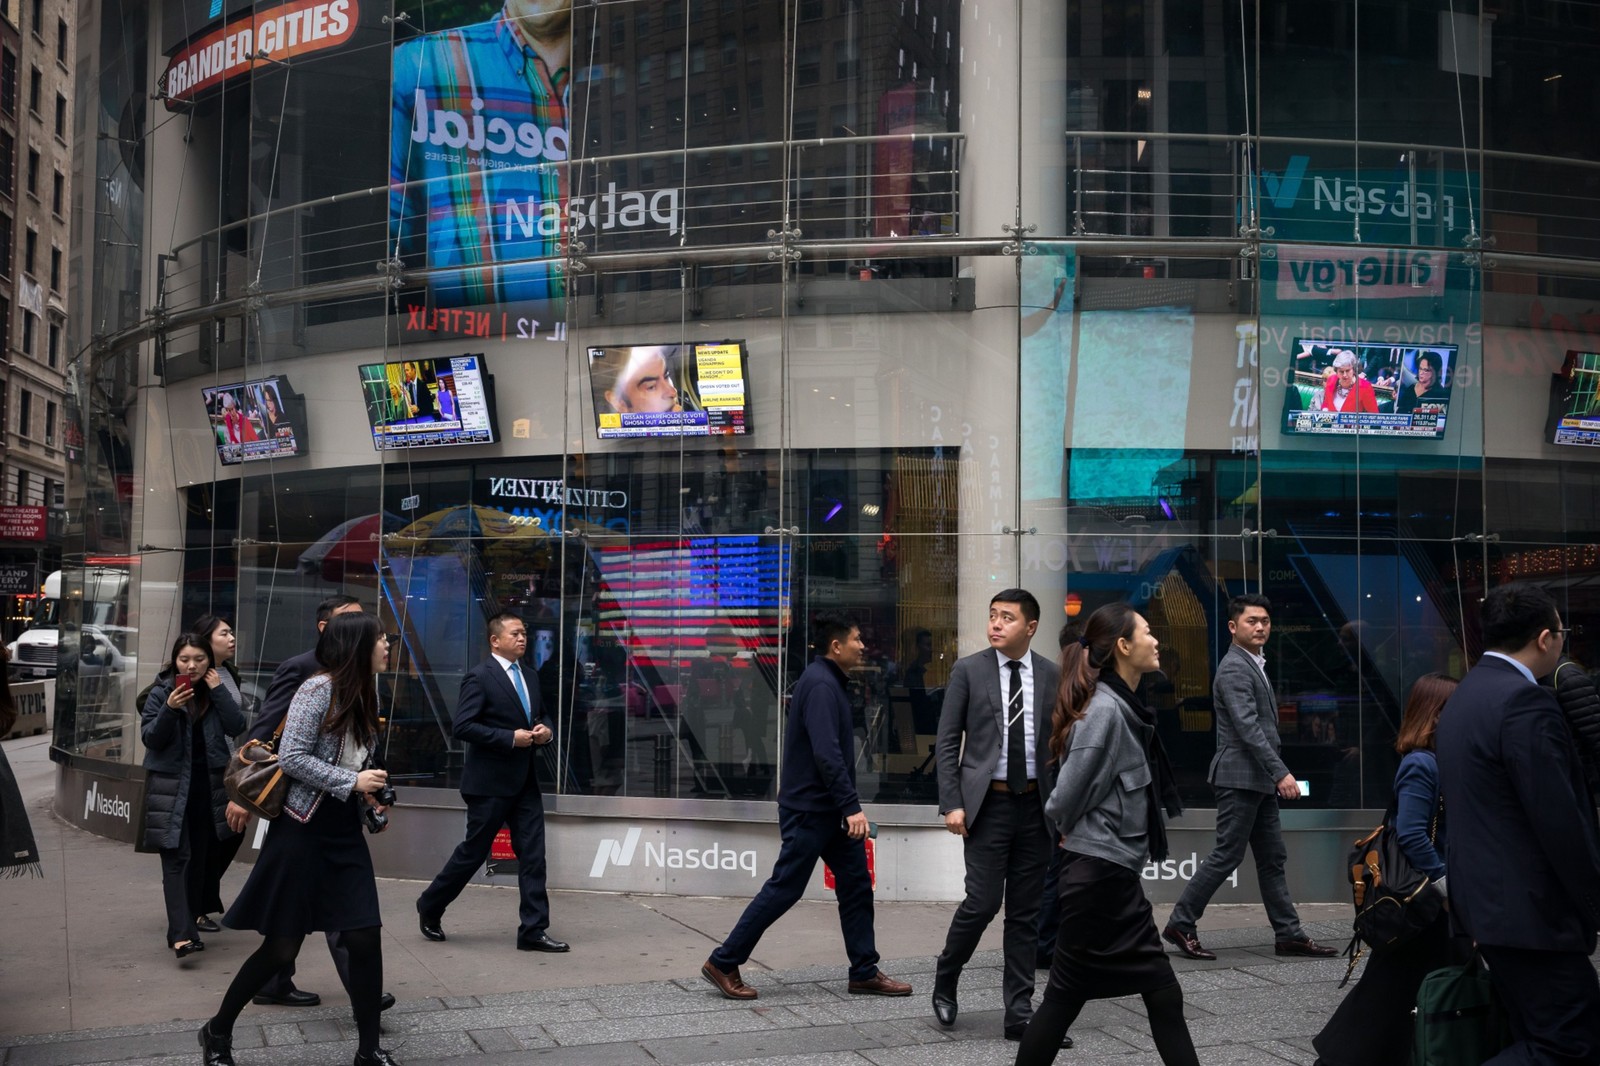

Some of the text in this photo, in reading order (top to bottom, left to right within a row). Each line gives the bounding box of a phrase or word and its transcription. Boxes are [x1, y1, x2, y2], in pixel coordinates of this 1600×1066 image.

[167, 0, 349, 101] BRANDED CITIES
[505, 181, 678, 237] Nasdaq
[1314, 176, 1454, 232] Nasdaq
[97, 792, 130, 824] Nasdaq
[644, 841, 757, 878] Nasdaq
[1141, 852, 1238, 888] asd
